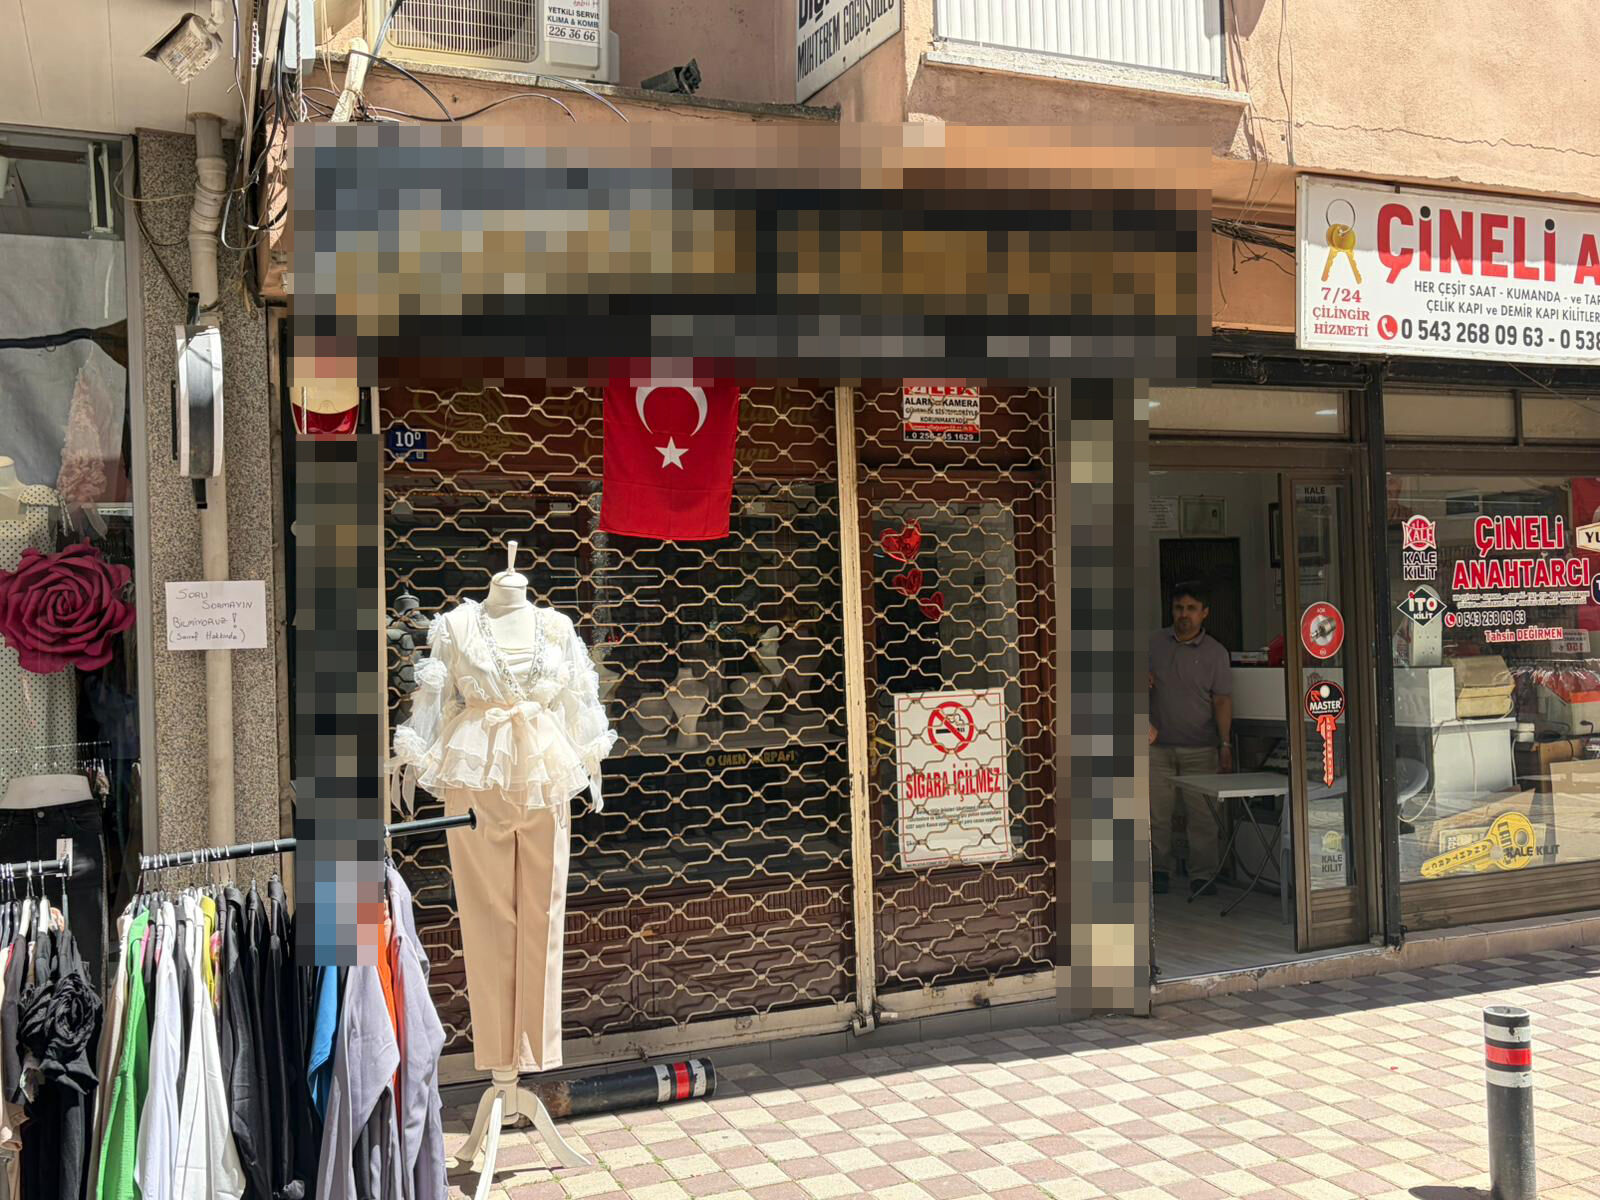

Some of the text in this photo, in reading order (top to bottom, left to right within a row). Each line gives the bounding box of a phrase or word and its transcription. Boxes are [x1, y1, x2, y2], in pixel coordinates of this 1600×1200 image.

[549, 26, 596, 41] 226 36 66
[1321, 287, 1362, 304] 7/24
[1414, 281, 1435, 293] HER
[1438, 280, 1466, 297] ÇEŞİT
[1469, 284, 1496, 298] SAAT
[1506, 287, 1561, 303] KUMANDA
[1570, 295, 1582, 304] ve
[1312, 305, 1370, 321] ÇİLİNGİR
[1426, 298, 1455, 315] ÇELİK
[1458, 302, 1483, 315] KAPI
[1486, 306, 1498, 316] ve
[1501, 302, 1533, 319] DEMİR
[1535, 307, 1559, 320] KAPI
[1314, 322, 1369, 337] HİZMETİ
[1401, 318, 1412, 340] 0
[1418, 320, 1451, 342] 543
[1456, 322, 1490, 344] 268
[1495, 324, 1518, 346] 09
[1523, 326, 1544, 348] 63
[1560, 329, 1571, 349] 0
[1575, 330, 1600, 351] 538
[942, 399, 979, 408] KAMERA
[954, 433, 974, 441] 1629
[1304, 486, 1326, 495] KALE
[1405, 527, 1434, 543] KALE
[1402, 551, 1438, 565] KALE
[1452, 558, 1591, 590] ANAHTARCI
[1455, 610, 1526, 628] 0 543 268 09 63
[1484, 628, 1516, 643] Tahsin
[1516, 625, 1564, 641] DEĞİRMEN
[1309, 700, 1341, 711] MASTER
[953, 762, 1001, 802] İÇİLMEZ
[1321, 854, 1343, 864] KALE
